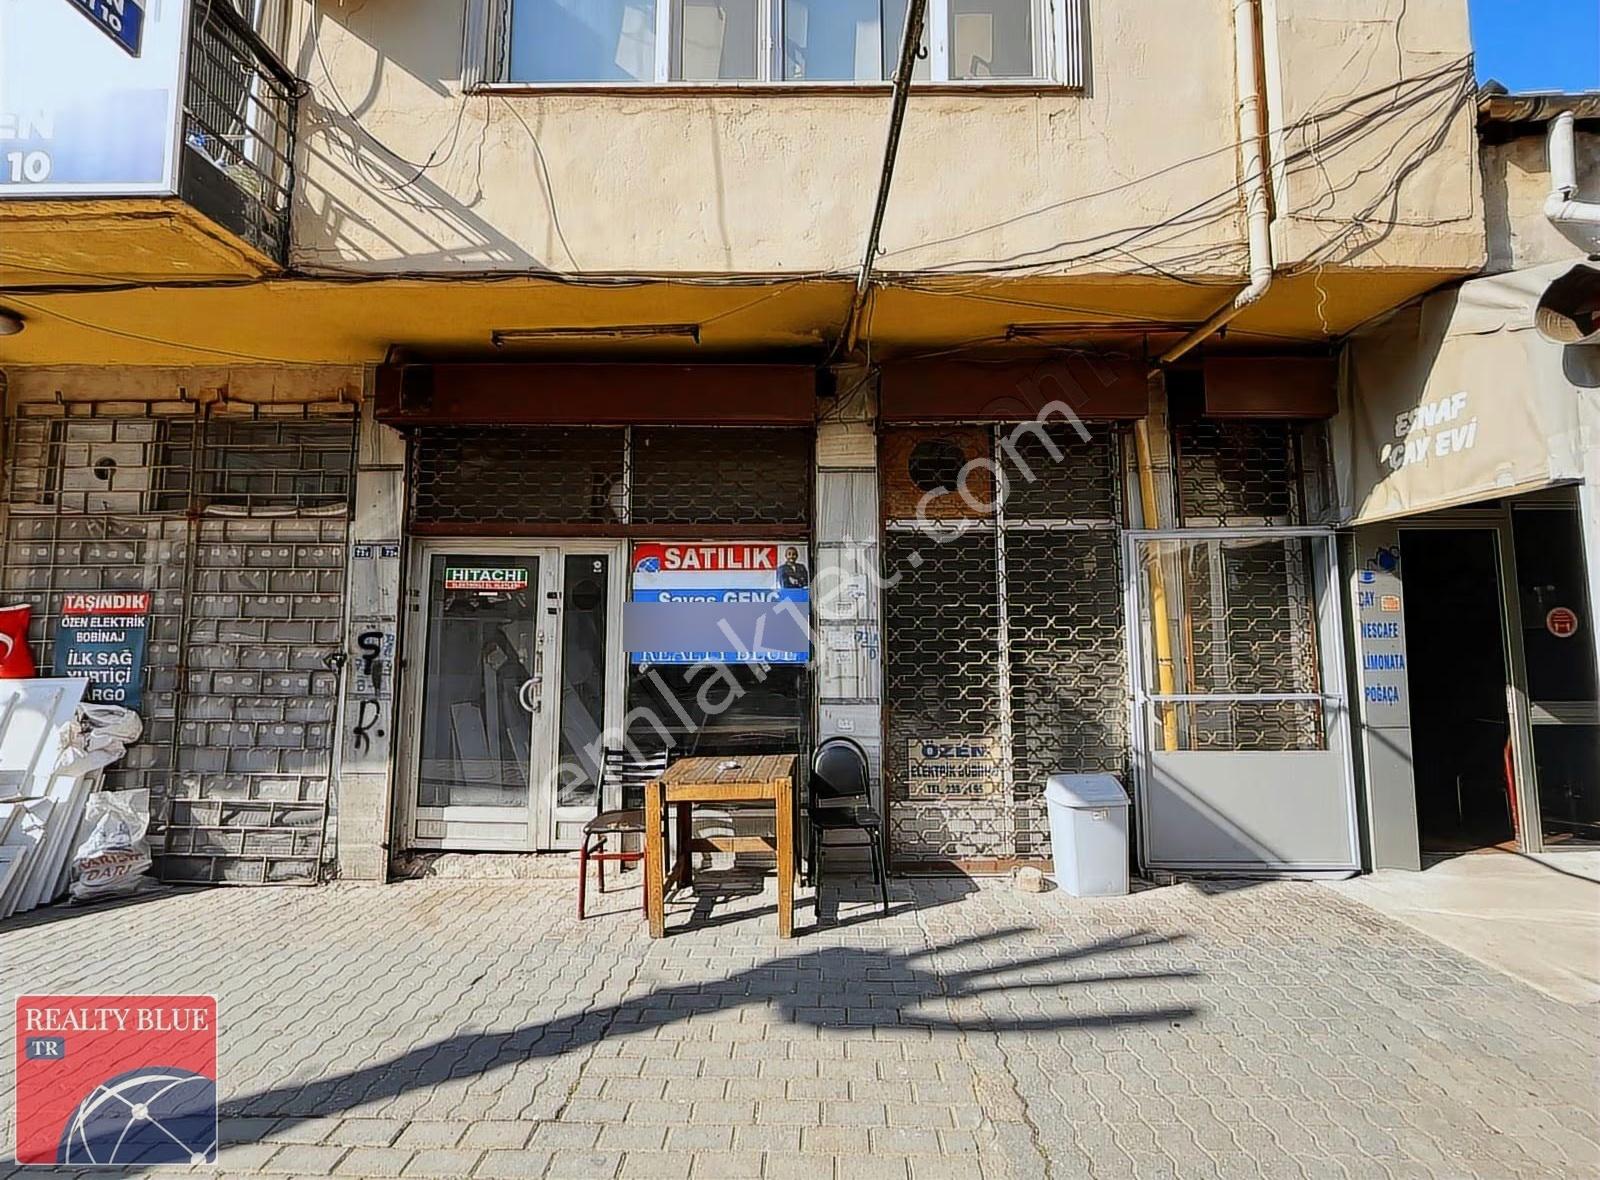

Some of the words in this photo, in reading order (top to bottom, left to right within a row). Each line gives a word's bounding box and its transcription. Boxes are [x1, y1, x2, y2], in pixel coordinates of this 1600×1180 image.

[7, 151, 51, 183] 10
[1435, 416, 1478, 457] EVİ
[663, 547, 773, 570] SATILIK
[452, 568, 521, 581] HITACHI
[66, 594, 145, 612] TAŞINDIK
[61, 614, 88, 628] ÖZEN
[90, 614, 145, 628] ELEKTRİK
[76, 629, 126, 643] BOBİNAJ
[1361, 622, 1399, 639] NESCAFE
[67, 649, 93, 666] İLK
[97, 649, 133, 666] SAĞ
[1363, 653, 1406, 671] LİMONATA
[1365, 684, 1399, 706] POĞAÇA
